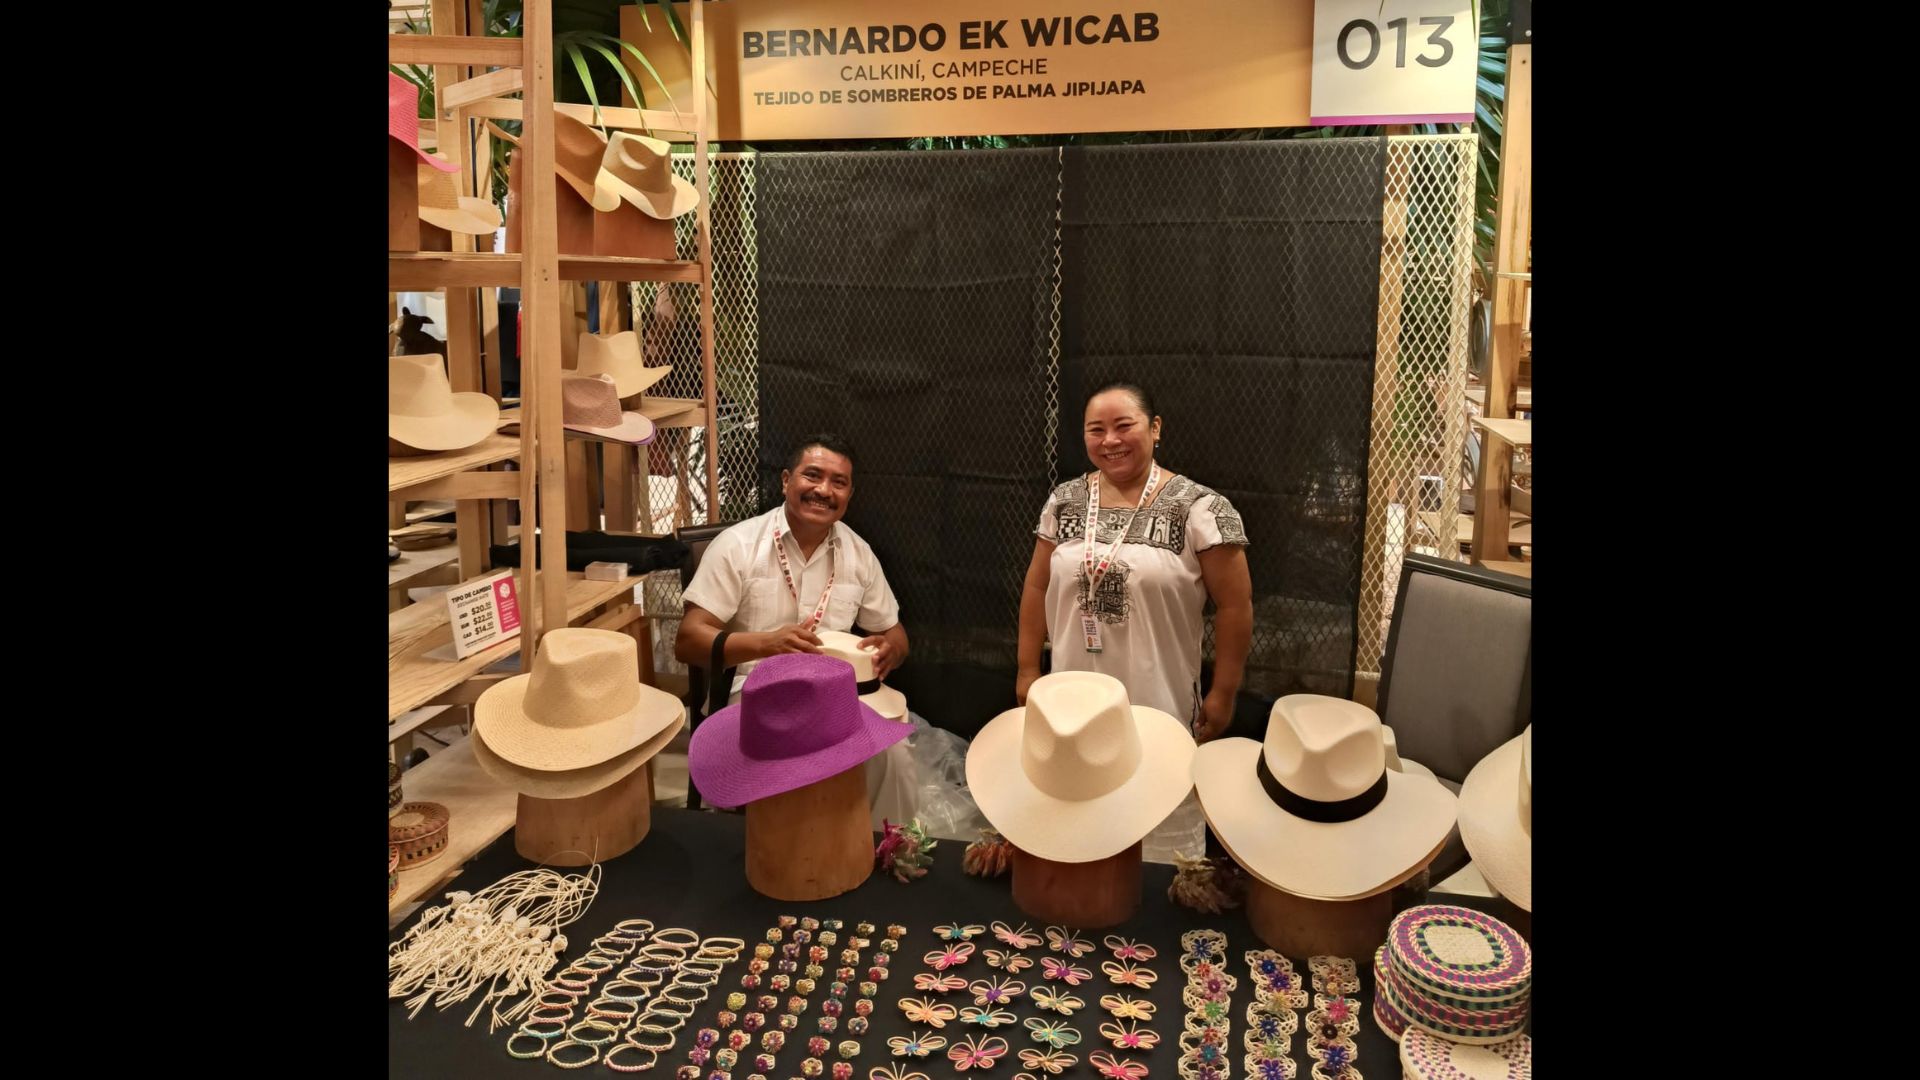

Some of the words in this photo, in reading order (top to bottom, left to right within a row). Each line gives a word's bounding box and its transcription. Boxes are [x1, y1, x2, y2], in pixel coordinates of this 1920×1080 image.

[743, 23, 947, 58] BERNARDO
[959, 20, 1009, 50] EK
[1021, 12, 1160, 47] WICAB
[1336, 16, 1455, 70] 013
[840, 60, 926, 82] CALKINÍ,
[932, 58, 1048, 79] CAMPECHE
[754, 91, 815, 106] TEJIDO
[819, 90, 842, 104] DE
[847, 87, 957, 104] SOMBREROS
[963, 86, 987, 100] DE
[993, 83, 1056, 99] PALMA
[1062, 80, 1146, 96] JIPIJAPA
[451, 595, 464, 603] TIPO
[472, 585, 492, 596] CAMBIO
